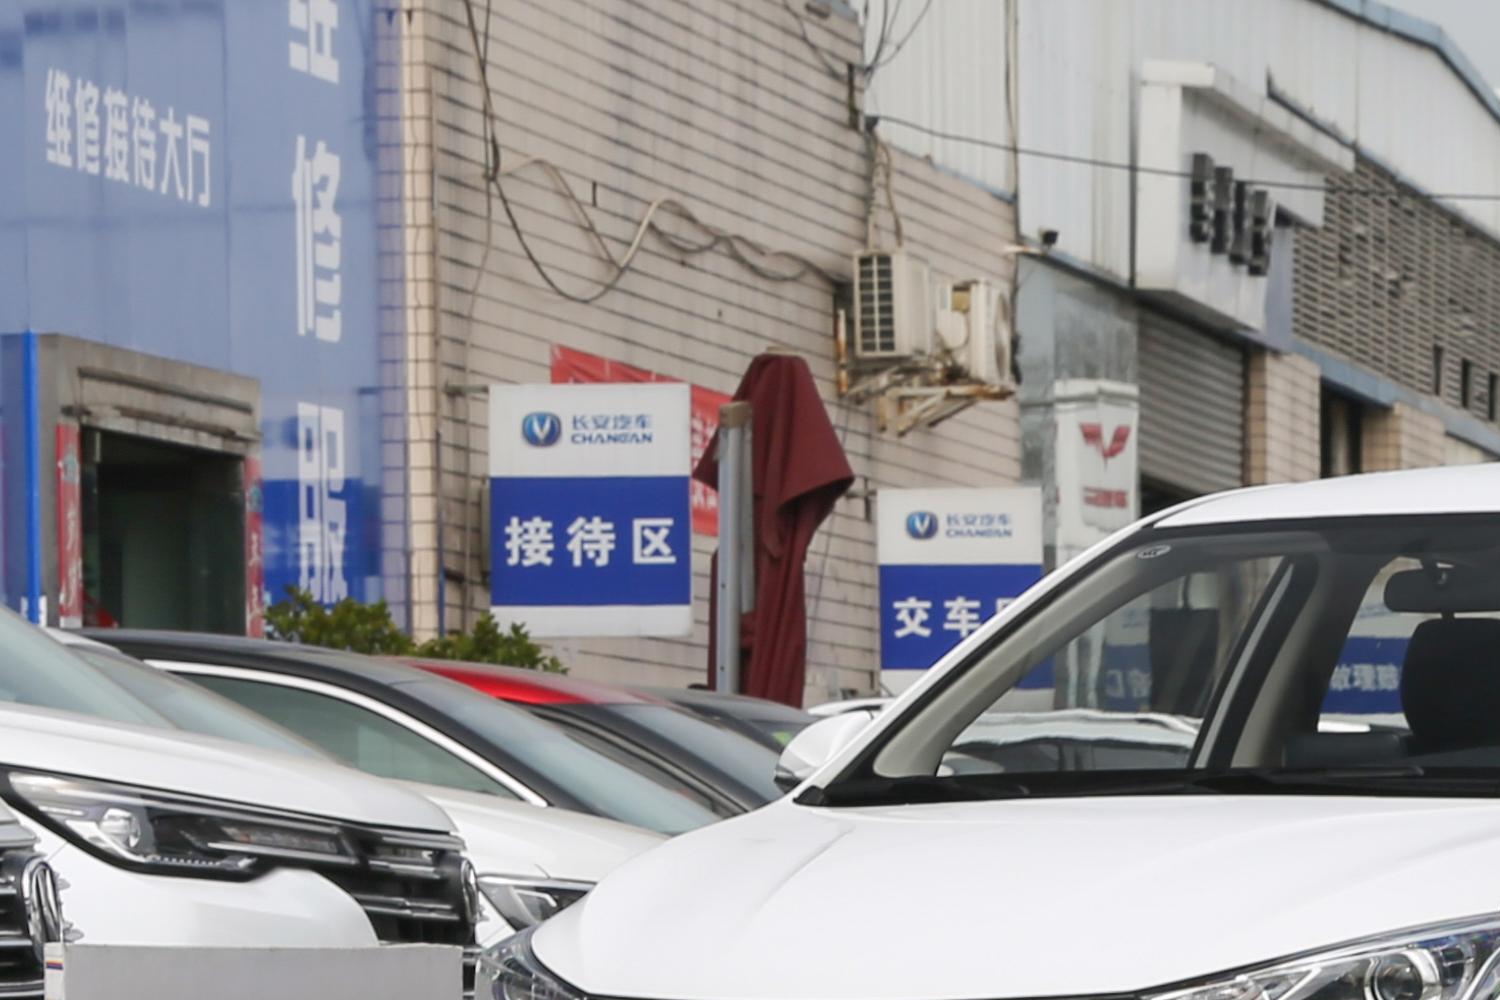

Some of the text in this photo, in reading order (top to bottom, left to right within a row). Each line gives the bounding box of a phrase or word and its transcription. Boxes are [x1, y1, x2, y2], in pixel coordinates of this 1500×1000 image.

[46, 66, 210, 207] 维修接待大厅
[571, 414, 653, 431] 长安汽车
[571, 432, 653, 445] CHANGAN
[505, 516, 677, 567] 接待区
[893, 597, 1019, 638] 交车
